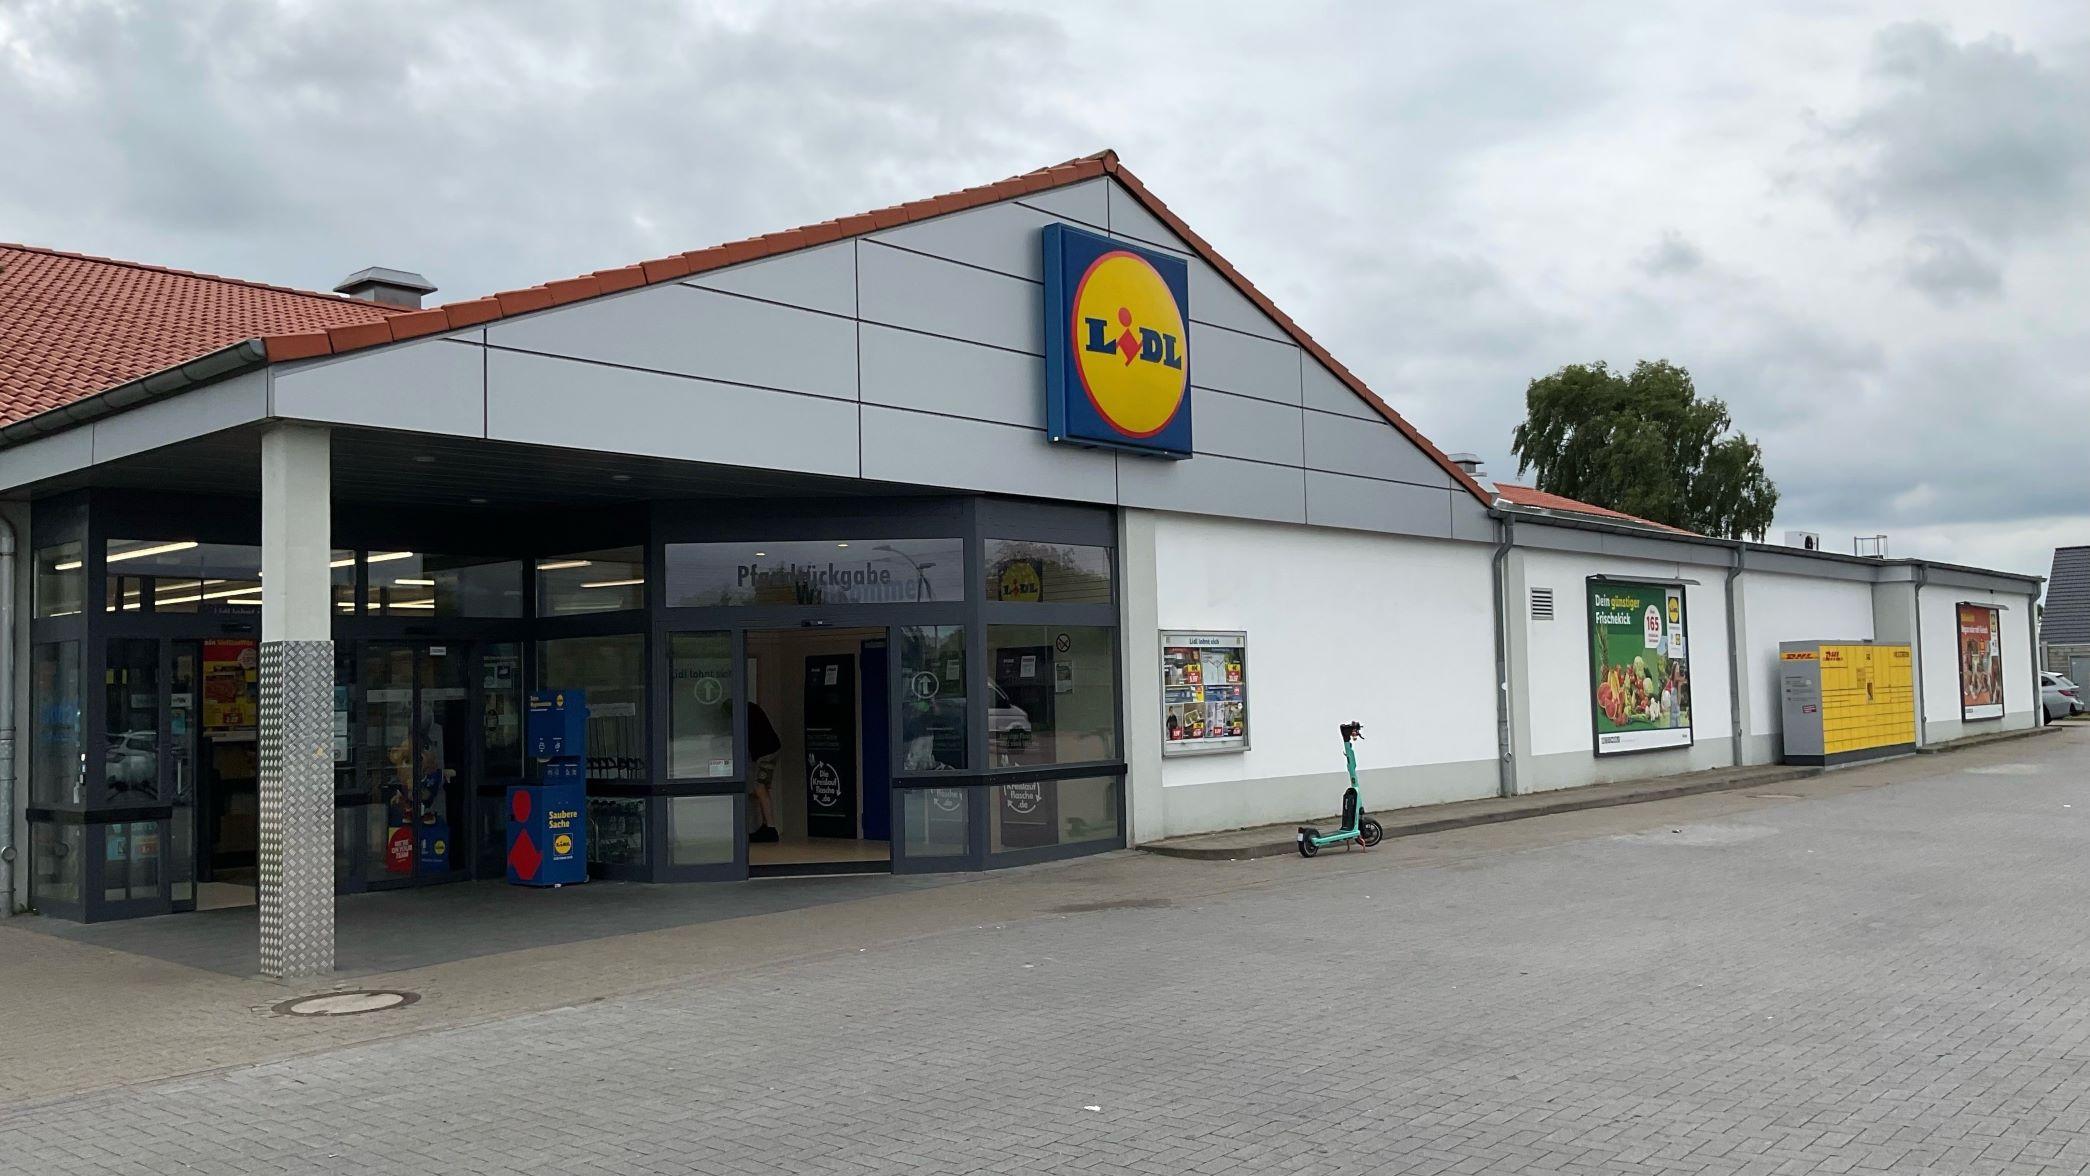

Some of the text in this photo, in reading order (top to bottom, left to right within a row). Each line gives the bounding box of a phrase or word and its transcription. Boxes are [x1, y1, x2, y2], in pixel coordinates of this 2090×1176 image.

[1594, 594, 1610, 607] Dein
[1611, 595, 1640, 611] günstiger
[1595, 611, 1631, 625] Frischekick
[1646, 615, 1659, 631] 165
[548, 810, 578, 820] Saubere
[548, 819, 570, 829] Sache
